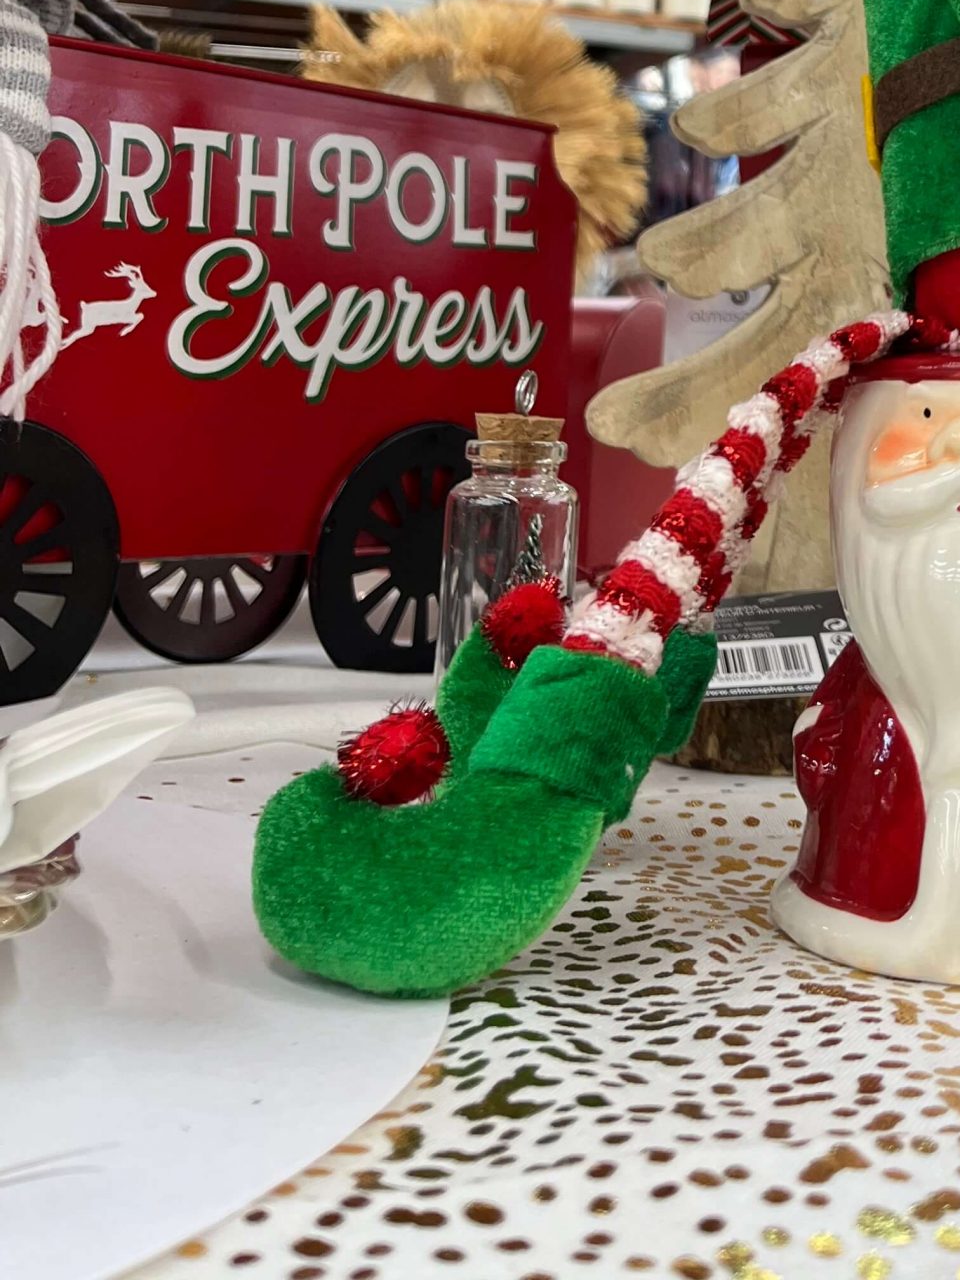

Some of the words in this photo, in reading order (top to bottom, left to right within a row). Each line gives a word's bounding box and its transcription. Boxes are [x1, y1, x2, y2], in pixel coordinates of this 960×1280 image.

[36, 114, 297, 236] ORTH
[309, 131, 541, 252] POLE
[166, 236, 546, 404] Express
